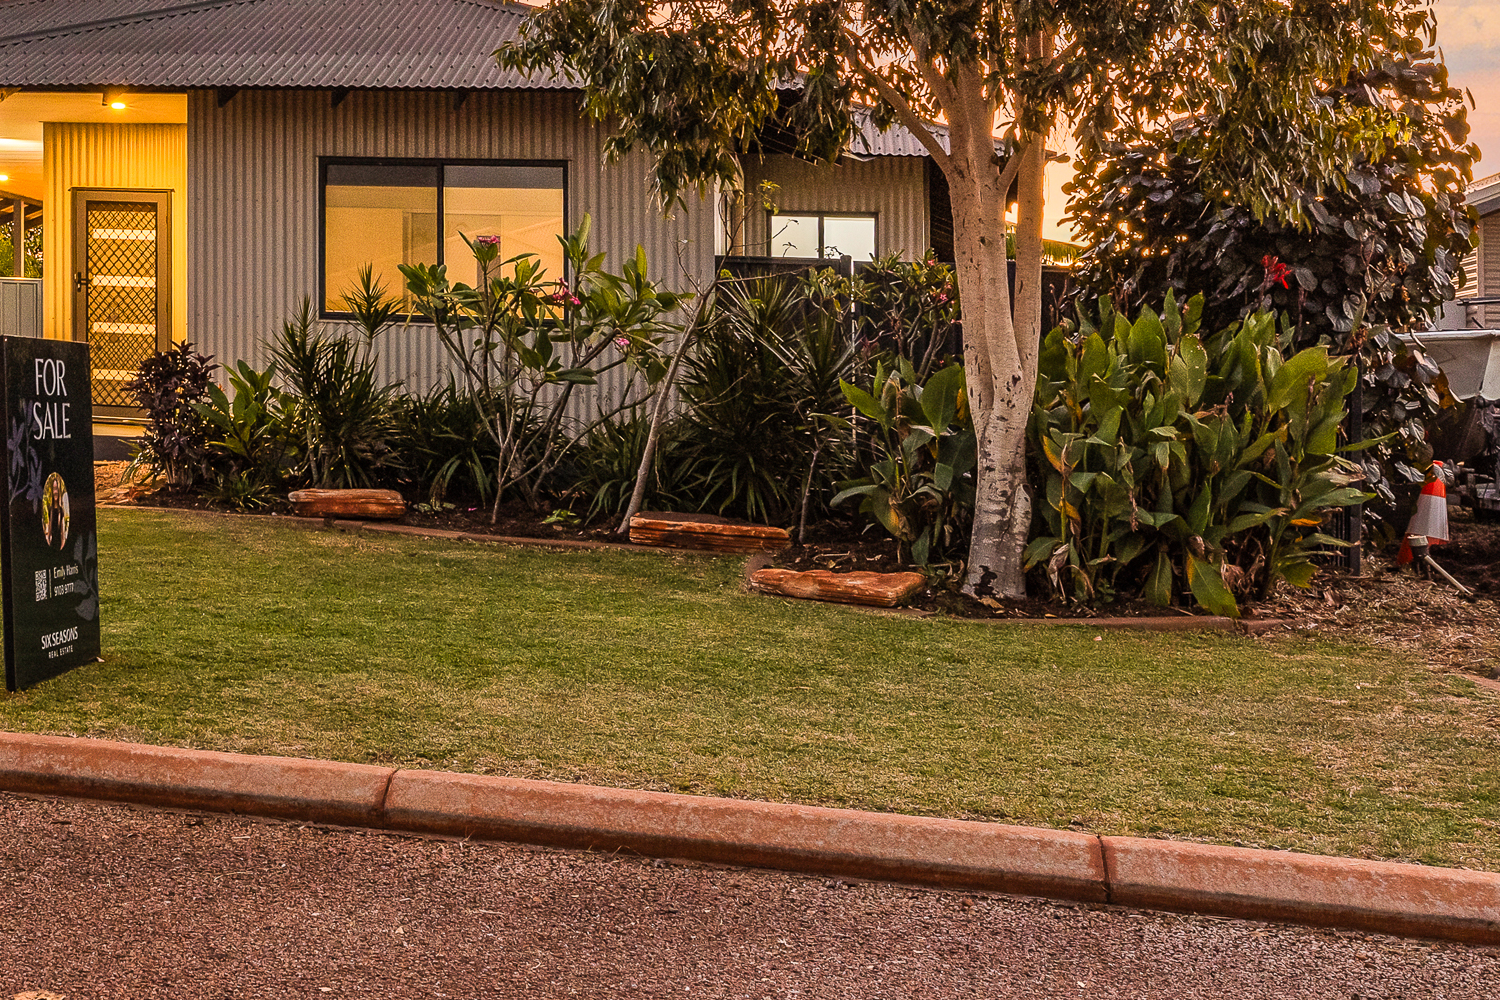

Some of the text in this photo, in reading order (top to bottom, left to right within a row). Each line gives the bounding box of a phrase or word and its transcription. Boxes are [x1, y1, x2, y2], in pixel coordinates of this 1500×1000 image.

[34, 358, 68, 397] FOR
[33, 402, 72, 440] SALE
[41, 626, 79, 650] SIX SEASONS
